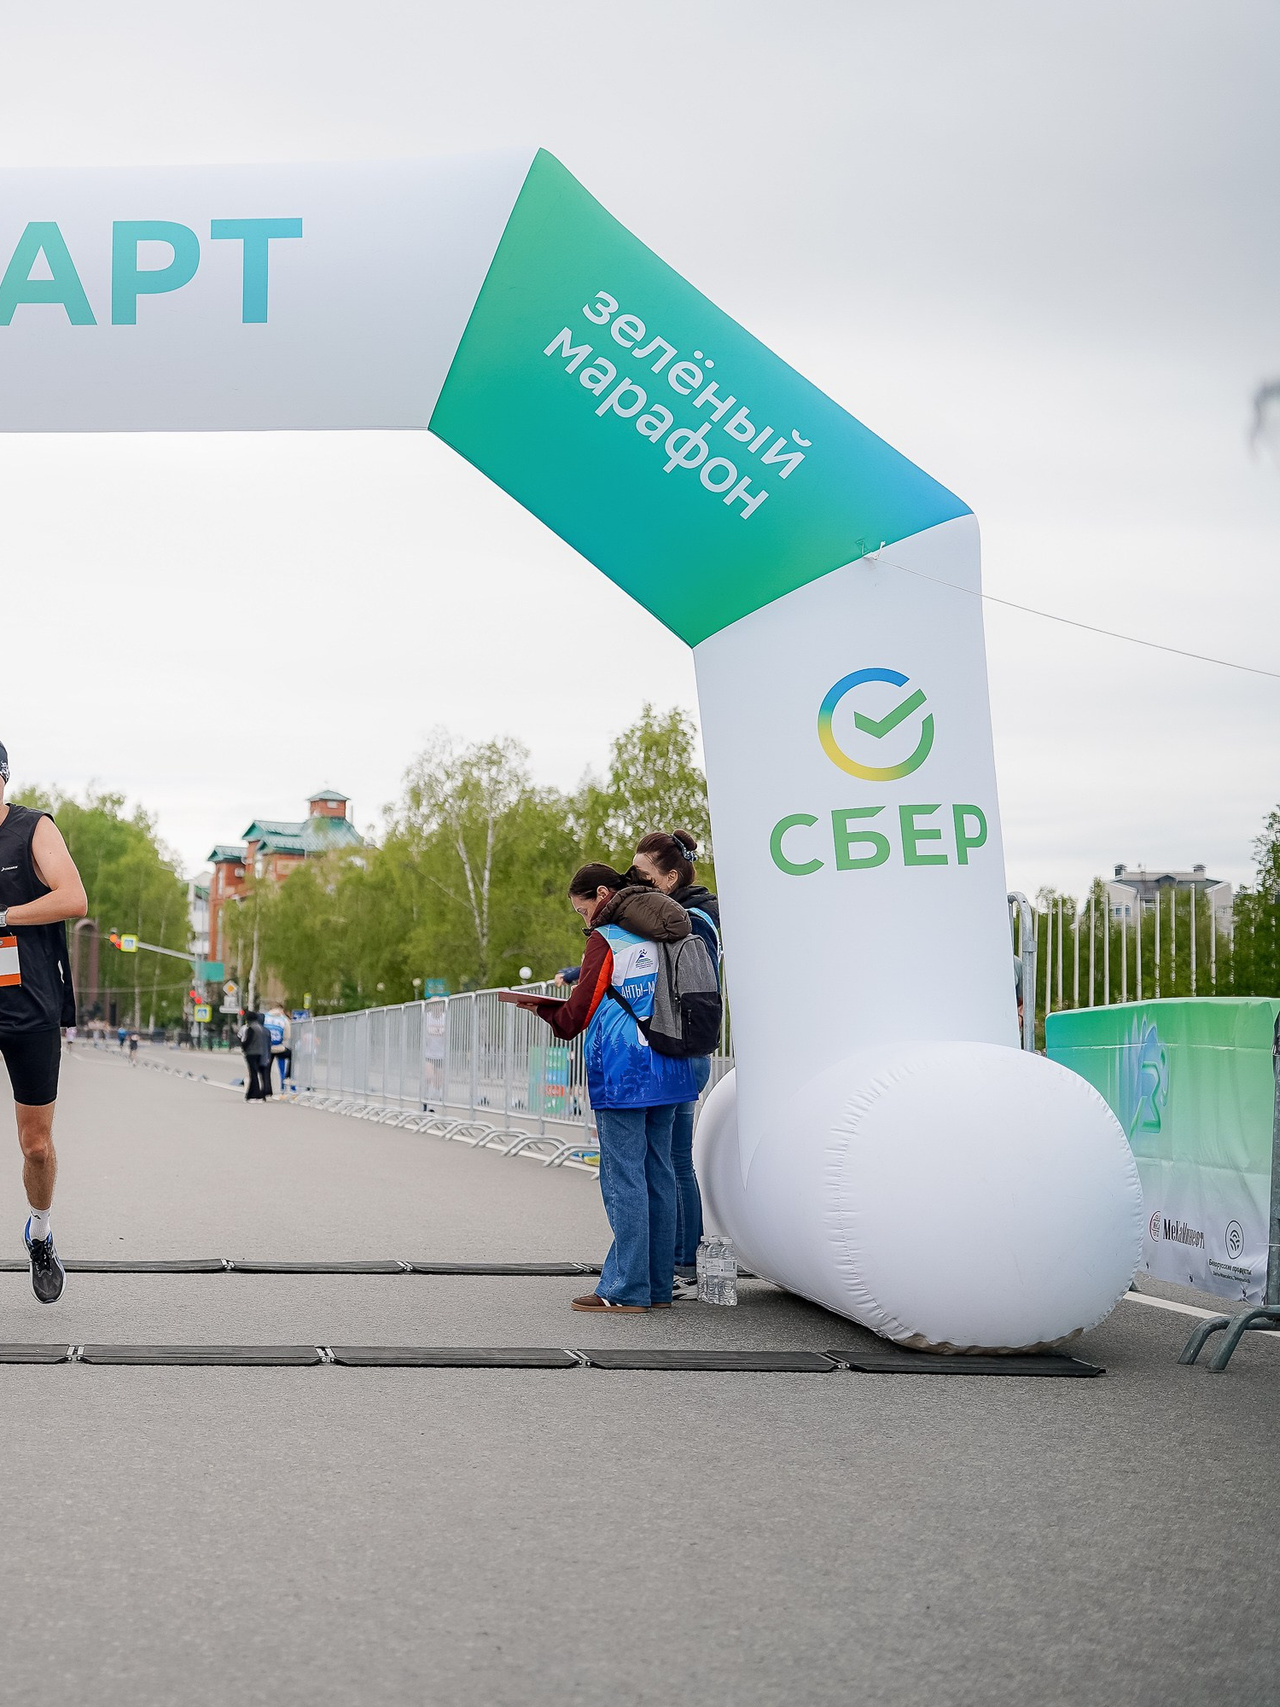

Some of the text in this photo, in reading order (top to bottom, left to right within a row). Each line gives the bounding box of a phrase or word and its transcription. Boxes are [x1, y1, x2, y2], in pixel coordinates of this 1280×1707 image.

[543, 326, 770, 520] марафон
[582, 290, 813, 480] зелёный
[769, 803, 988, 876] СБЕР
